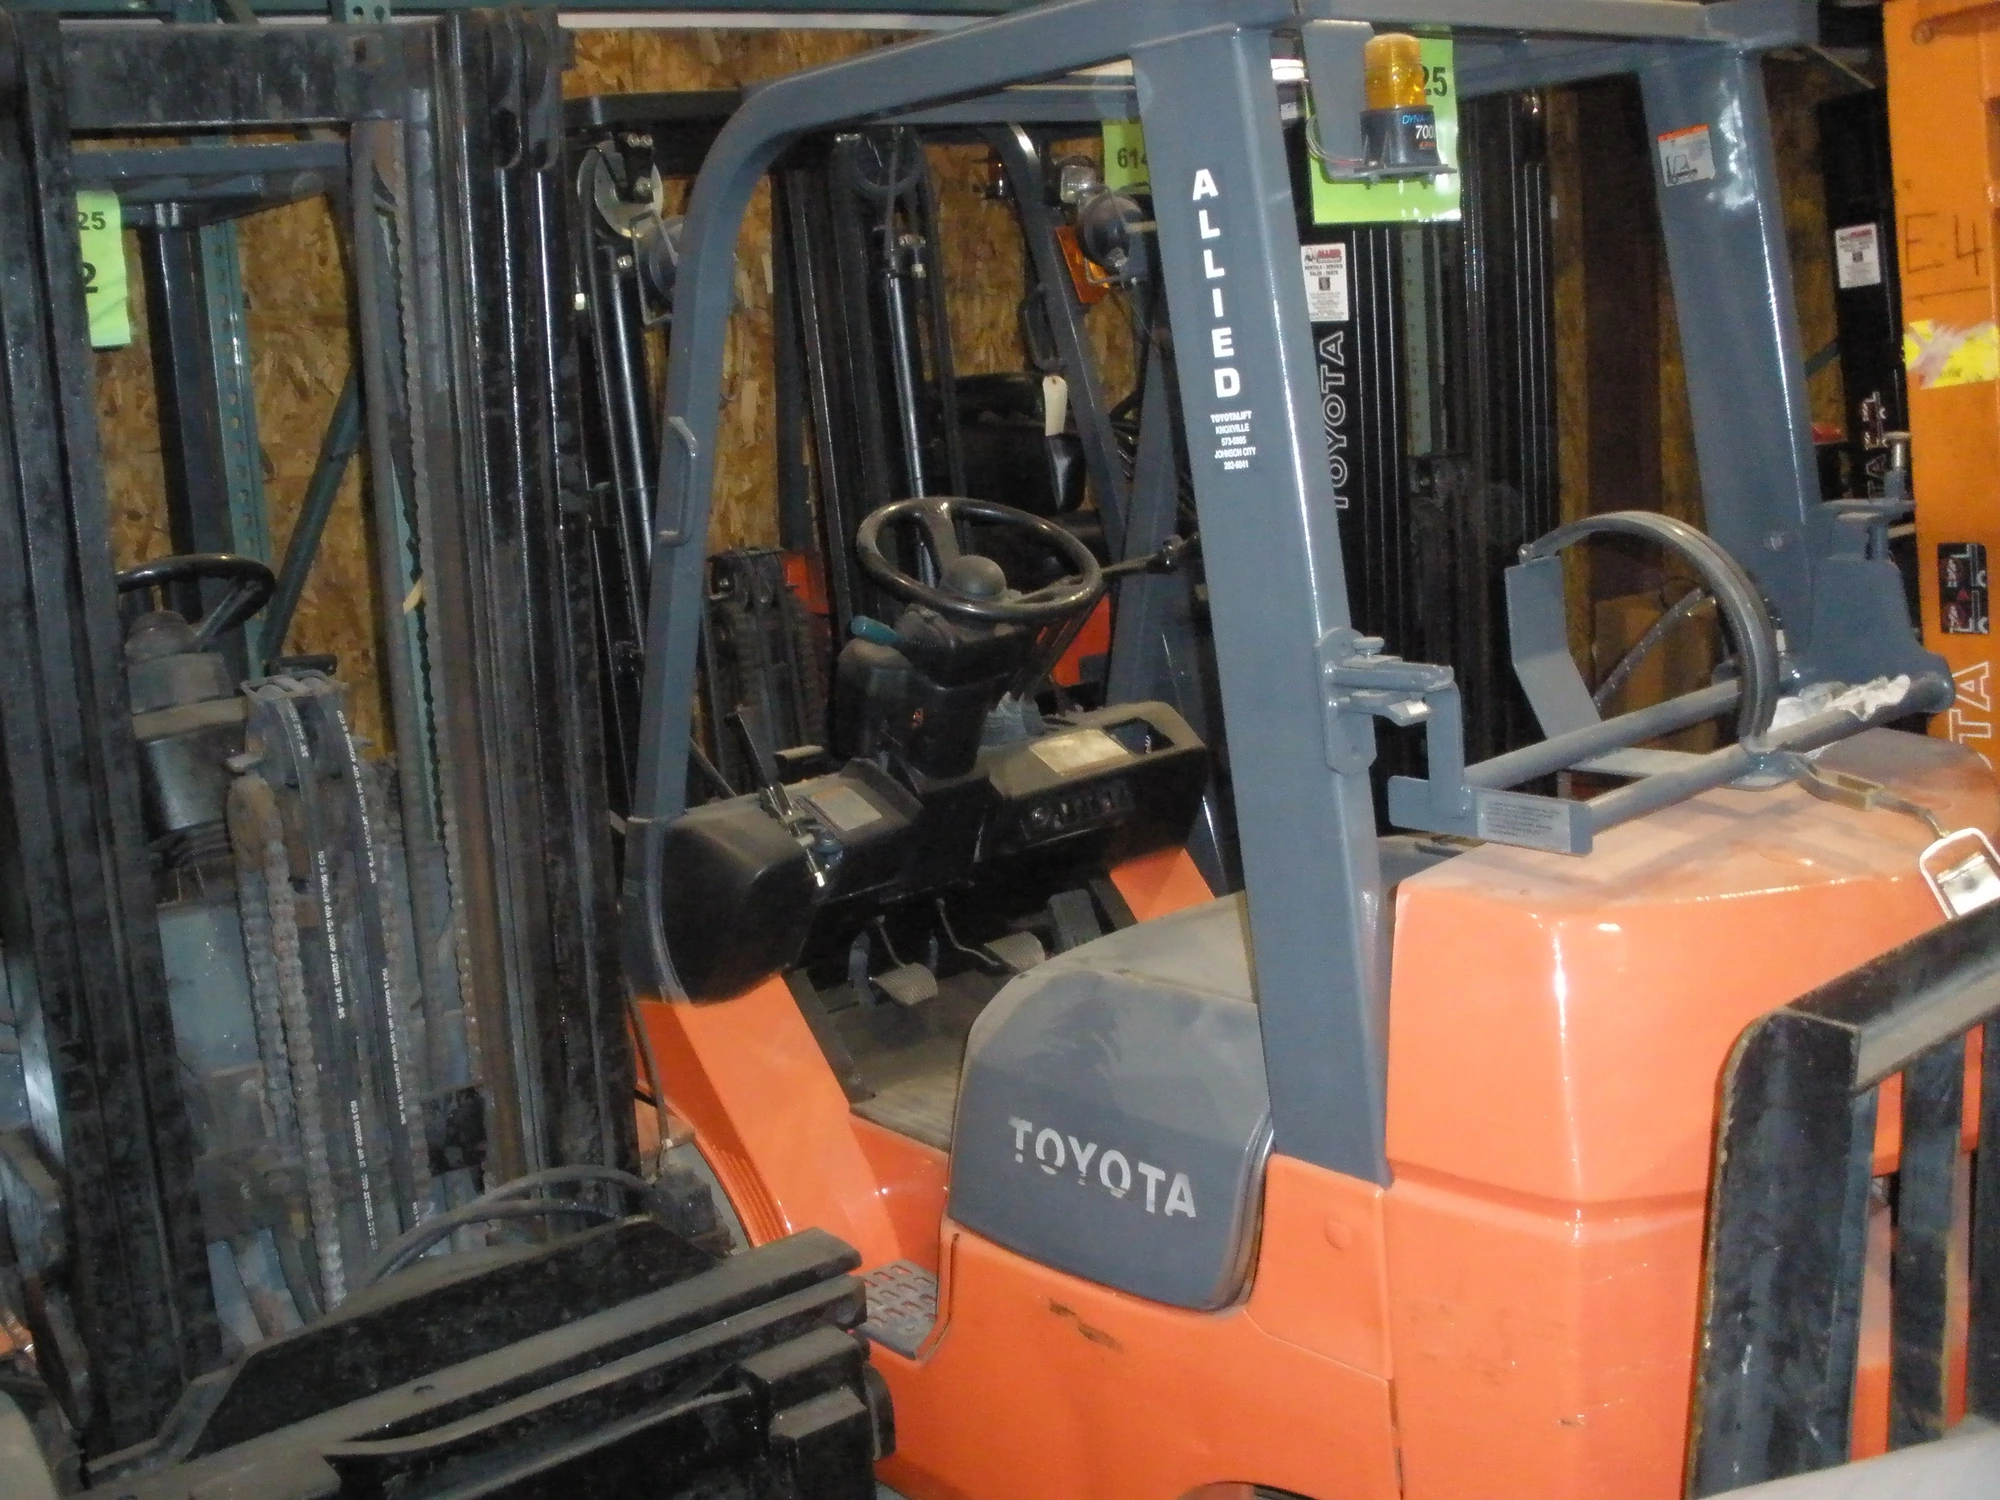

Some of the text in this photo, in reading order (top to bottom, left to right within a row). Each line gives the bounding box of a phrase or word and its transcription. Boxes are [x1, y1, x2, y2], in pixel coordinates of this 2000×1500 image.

[1193, 168, 1241, 398] ALLIED
[1214, 446, 1256, 459] JOHNSON CITY
[1215, 422, 1250, 434] KNOXVILLE
[1008, 1115, 1196, 1218] TOYOTA
